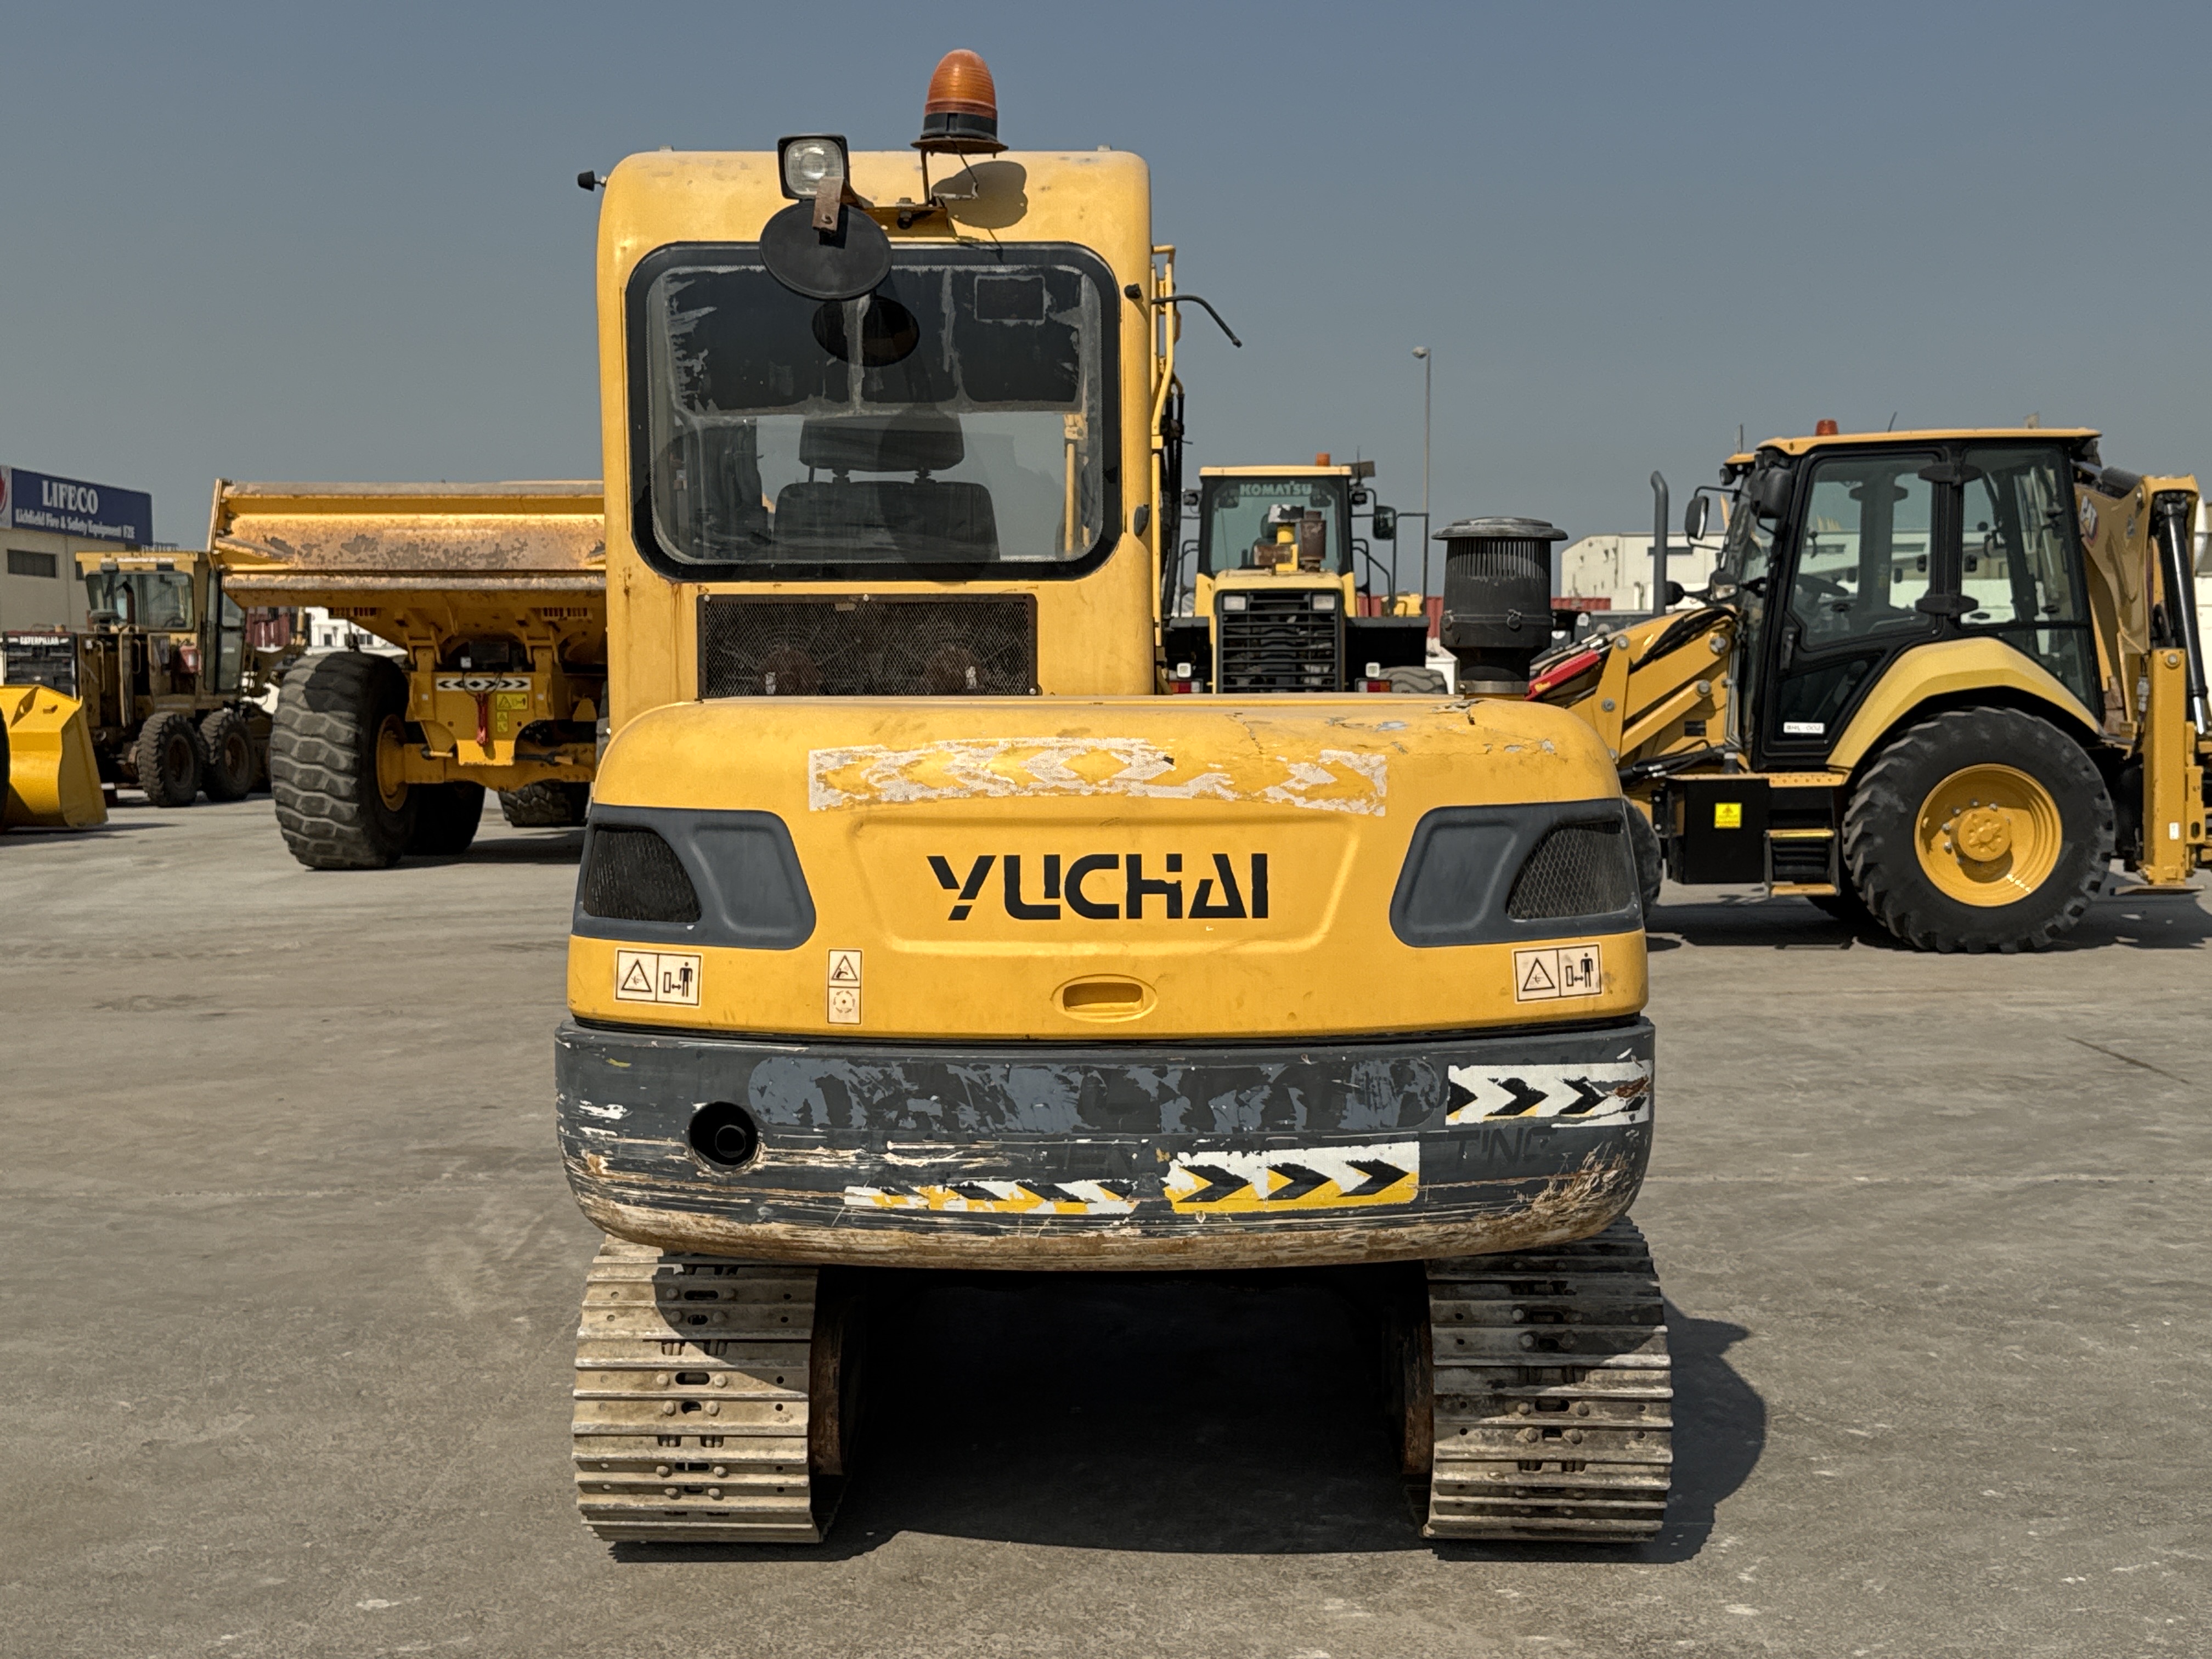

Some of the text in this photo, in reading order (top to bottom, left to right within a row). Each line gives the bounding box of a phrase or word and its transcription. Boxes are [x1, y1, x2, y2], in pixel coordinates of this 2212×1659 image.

[42, 479, 99, 515] LIFECO
[1239, 481, 1313, 496] KOMATSU
[926, 853, 1269, 921] YUCHAI
